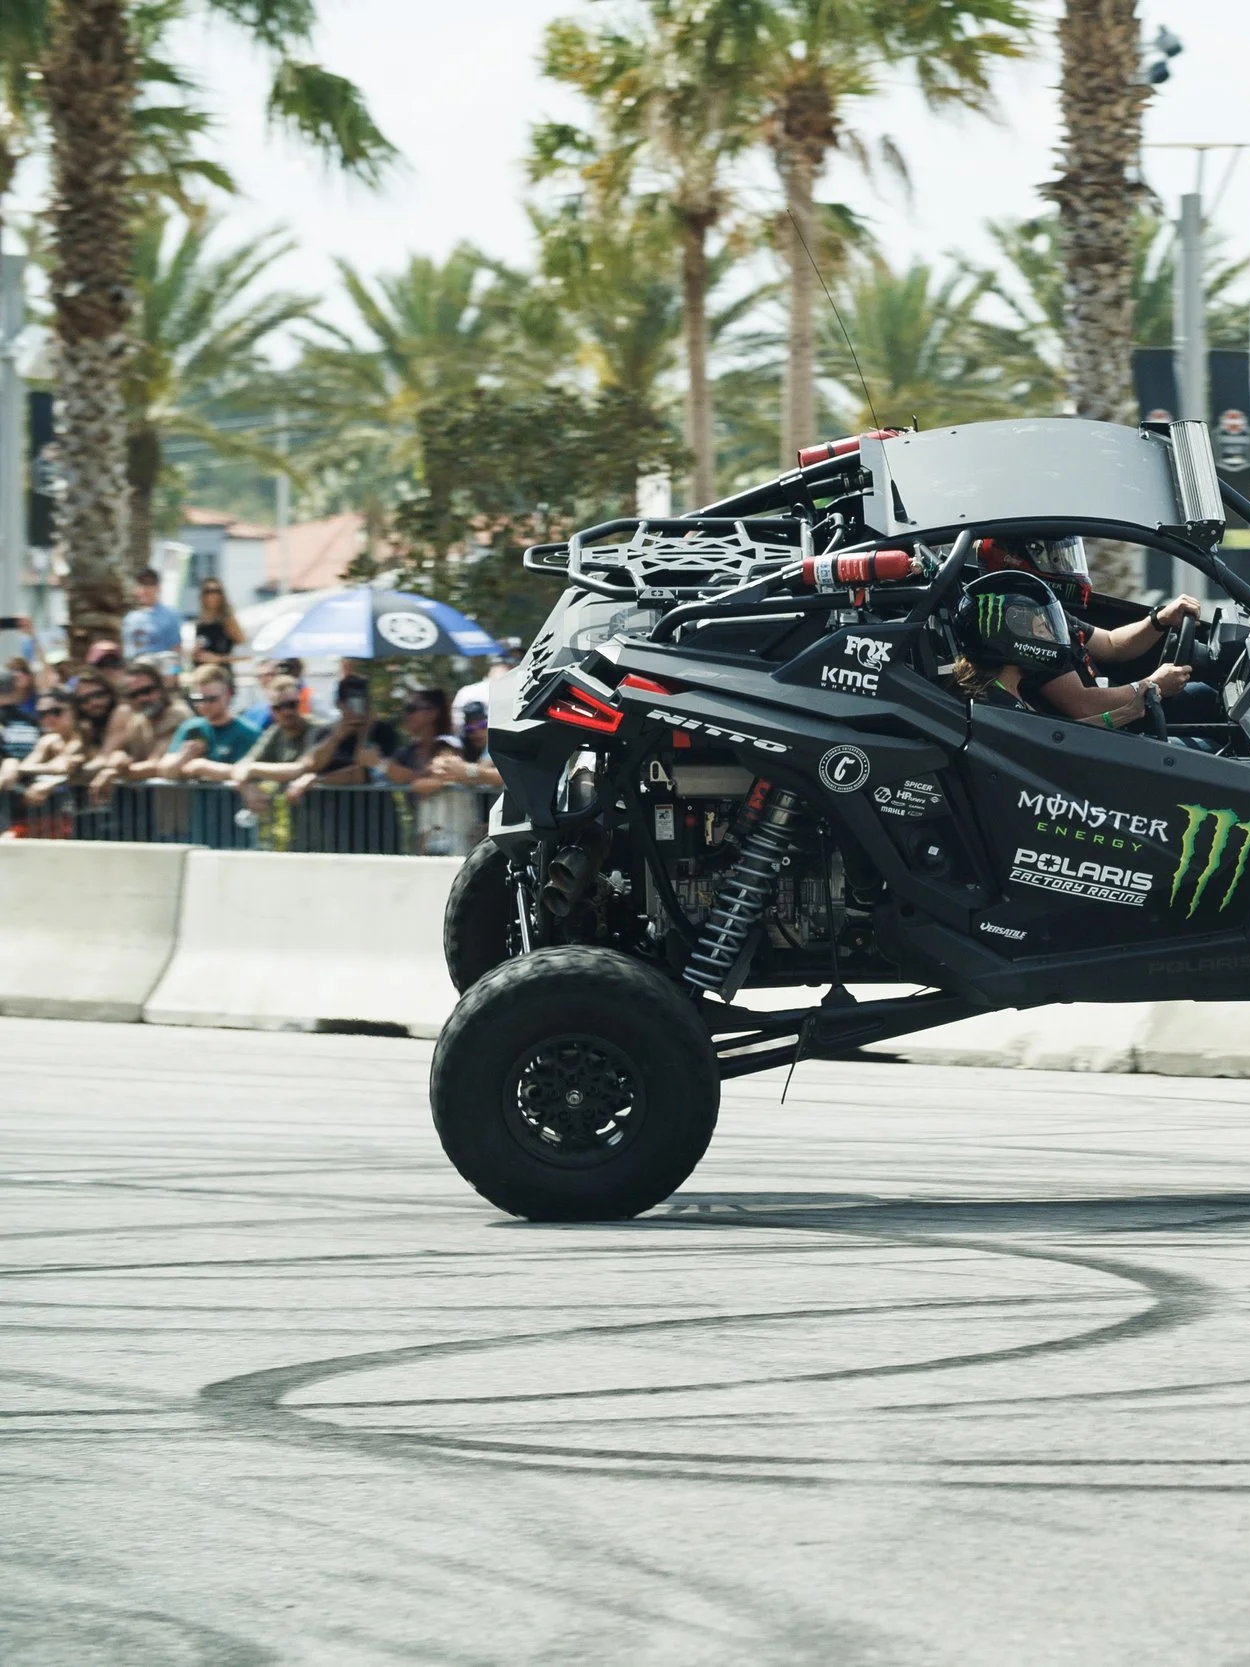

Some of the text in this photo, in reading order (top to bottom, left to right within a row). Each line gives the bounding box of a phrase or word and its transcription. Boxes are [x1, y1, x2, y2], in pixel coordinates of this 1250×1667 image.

[844, 635, 893, 672] FOX
[1013, 641, 1058, 658] MONSTER
[821, 682, 876, 696] WHEELS
[646, 709, 787, 752] NITTO
[904, 780, 933, 791] SPICER
[881, 806, 905, 816] MAHLE
[1018, 790, 1168, 842] MONSTER
[1037, 821, 1143, 852] ENERGY
[1013, 848, 1153, 891] POLARIS
[1010, 870, 1146, 903] FACTORY RACING
[980, 921, 1028, 939] VERSATILE
